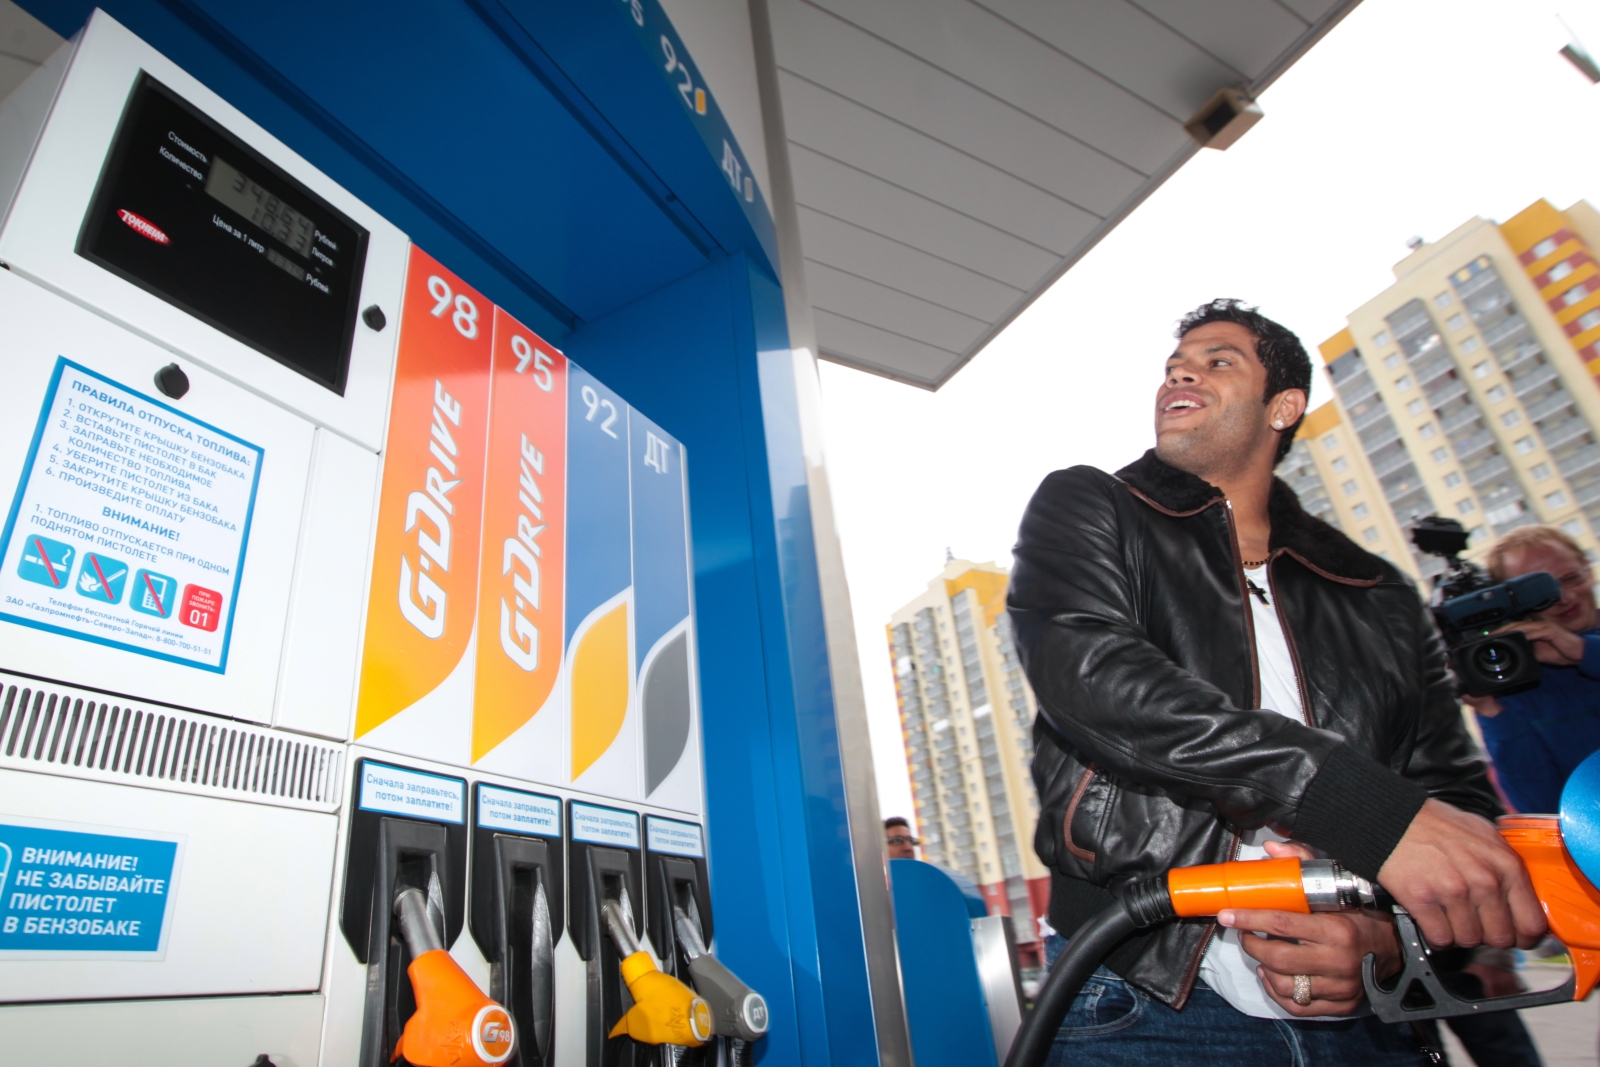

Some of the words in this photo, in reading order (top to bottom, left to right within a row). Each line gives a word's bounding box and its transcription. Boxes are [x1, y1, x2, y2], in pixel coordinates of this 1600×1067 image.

[622, 0, 644, 27] 5
[661, 34, 693, 110] 92
[159, 146, 203, 180] Количество
[168, 130, 207, 163] Стоимость
[121, 209, 165, 242] TOKHEIM
[212, 214, 232, 233] Цена
[233, 229, 242, 239] за
[248, 239, 265, 253] литр
[315, 230, 337, 250] Рублей
[312, 247, 334, 266] Литров
[306, 273, 329, 293] Рублей
[427, 275, 478, 339] 98
[511, 335, 554, 392] 95
[72, 380, 134, 415] ПРАВИЛА
[138, 410, 193, 441] ОТПУСКА
[196, 435, 250, 466] ТОПЛИВА:
[581, 385, 618, 439] 92
[60, 420, 69, 430] 3.
[72, 425, 136, 457] ЗАПРАВЬТЕ
[138, 453, 213, 488] НЕОБХОДИМОЕ
[63, 409, 72, 419] 2.
[76, 414, 131, 442] ВСТАВЬТЕ
[133, 438, 186, 466] ПИСТОЛЕТ
[189, 462, 195, 471] В
[198, 466, 217, 479] БАК
[67, 398, 75, 408] 1.
[78, 403, 142, 435] ОТКРУТИТЕ
[144, 431, 189, 456] КРЫШКУ
[191, 452, 245, 480] БЕНЗОБАКА
[644, 431, 670, 474] ДТ
[52, 443, 62, 453] 4.
[66, 448, 117, 474] УБЕРИТЕ
[119, 469, 174, 497] ПИСТОЛЕТ
[177, 491, 190, 502] ИЗ
[193, 498, 219, 513] БАКА
[68, 436, 141, 471] КОЛИЧЕСТВО
[144, 466, 191, 491] ТОПЛИВА
[45, 467, 55, 477] 6.
[59, 471, 142, 509] ПРОИЗВЕДИТЕ
[145, 500, 186, 523] ОПЛАТУ
[49, 454, 59, 465] 5.
[62, 459, 127, 491] ЗАКРУТИТЕ
[130, 485, 178, 508] КРЫШКУ
[180, 503, 236, 532] БЕНЗОБАКА
[31, 515, 94, 543] ПОДНЯТОМ
[97, 537, 158, 563] ПИСТОЛЕТЕ
[35, 504, 43, 513] 1.
[47, 508, 100, 531] ТОПЛИВО
[102, 526, 173, 556] ОТПУСКАЕТСЯ
[176, 551, 195, 564] ПРИ
[198, 558, 229, 575] ОДНОМ
[102, 506, 180, 542] ВНИМАНИЕ!
[191, 594, 215, 606] ПОЖАРЕ
[198, 590, 210, 598] ПРИ
[5, 596, 24, 606] ЗАО
[156, 635, 212, 656] 8-800-700-51-51
[48, 597, 83, 613] Телефон
[85, 606, 130, 626] бесплатной
[131, 619, 160, 634] Горячей
[161, 628, 183, 639] линии
[189, 609, 208, 627] 01
[366, 774, 404, 789] Сначала
[407, 783, 459, 800] заправьтесь,
[375, 791, 403, 802] потом
[406, 797, 452, 811] заплатите!
[482, 795, 511, 808] Сначала
[514, 802, 556, 816] заправьтесь,
[490, 810, 511, 819] потом
[513, 814, 551, 826] заплатите!
[575, 812, 599, 823] Сначала
[601, 828, 631, 838] заплатите!
[21, 847, 138, 872] ВНИМАНИЕ!
[15, 870, 45, 888] НЕ
[48, 872, 165, 895] ЗАБЫВАЙТЕ
[9, 892, 117, 913] ПИСТОЛЕТ
[3, 916, 19, 933] В
[23, 917, 141, 936] БЕНЗОБАКЕ
[752, 1006, 764, 1021] ДТ
